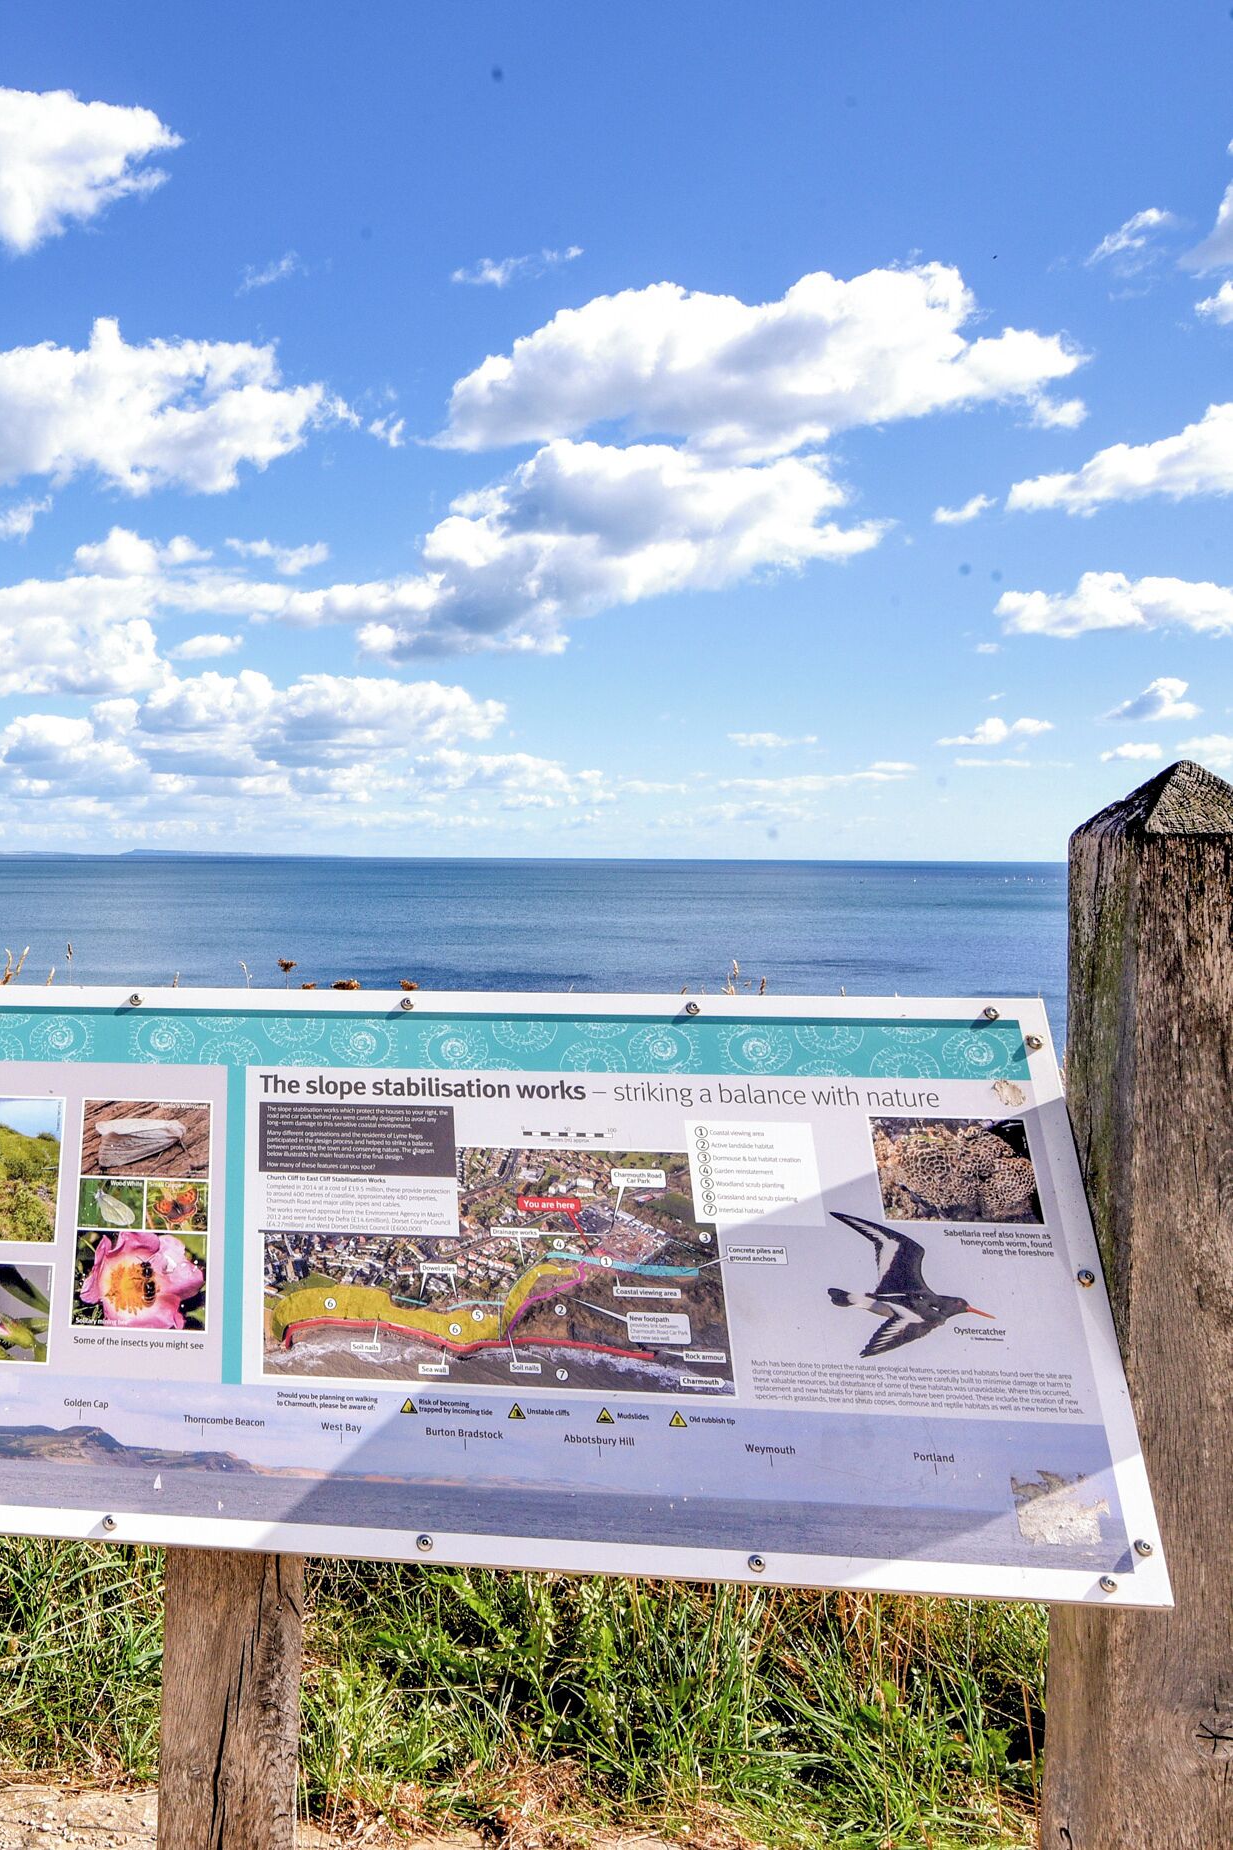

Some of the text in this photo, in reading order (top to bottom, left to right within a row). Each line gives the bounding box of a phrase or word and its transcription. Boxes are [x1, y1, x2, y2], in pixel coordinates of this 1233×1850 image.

[259, 1074, 940, 1108] The slope stabilisation works striking a balance with nature
[523, 1199, 540, 1208] You
[556, 1200, 575, 1210] here
[943, 1229, 981, 1238] Sabellaria
[982, 1230, 997, 1238] reef
[998, 1231, 1014, 1239] also
[1014, 1231, 1041, 1239] known
[960, 1238, 1053, 1249] honeycomb worm, found
[728, 1246, 755, 1254] Concrete
[982, 1247, 1055, 1257] along the foreshore
[639, 1289, 663, 1297] viewing
[953, 1326, 1006, 1336] Oystercatcher
[73, 1335, 96, 1345] Some
[96, 1337, 106, 1345] of
[106, 1337, 120, 1346] the
[120, 1338, 148, 1347] insects
[149, 1341, 164, 1349] you
[165, 1340, 188, 1351] might
[682, 1377, 720, 1386] Charmouth
[277, 1391, 298, 1399] Should
[319, 1393, 345, 1403] planning
[354, 1396, 378, 1404] walking
[63, 1398, 109, 1410] Golden Cap
[283, 1400, 319, 1409] Charmouth,
[339, 1402, 348, 1410] be
[418, 1398, 432, 1406] Risk
[439, 1399, 470, 1410] becoming
[418, 1406, 493, 1416] trapped by incoming tide
[526, 1408, 570, 1417] Unstable cliffs
[617, 1412, 650, 1420] Mudslides
[183, 1414, 265, 1427] Thorncombe Beacon
[688, 1415, 736, 1426] Old rubbish tip
[320, 1422, 362, 1434] West Bay
[425, 1427, 504, 1440] Burton Bradstock
[563, 1434, 635, 1447] Abbotsbury Hill
[744, 1443, 796, 1455] Weymouth
[913, 1452, 955, 1463] Portland
